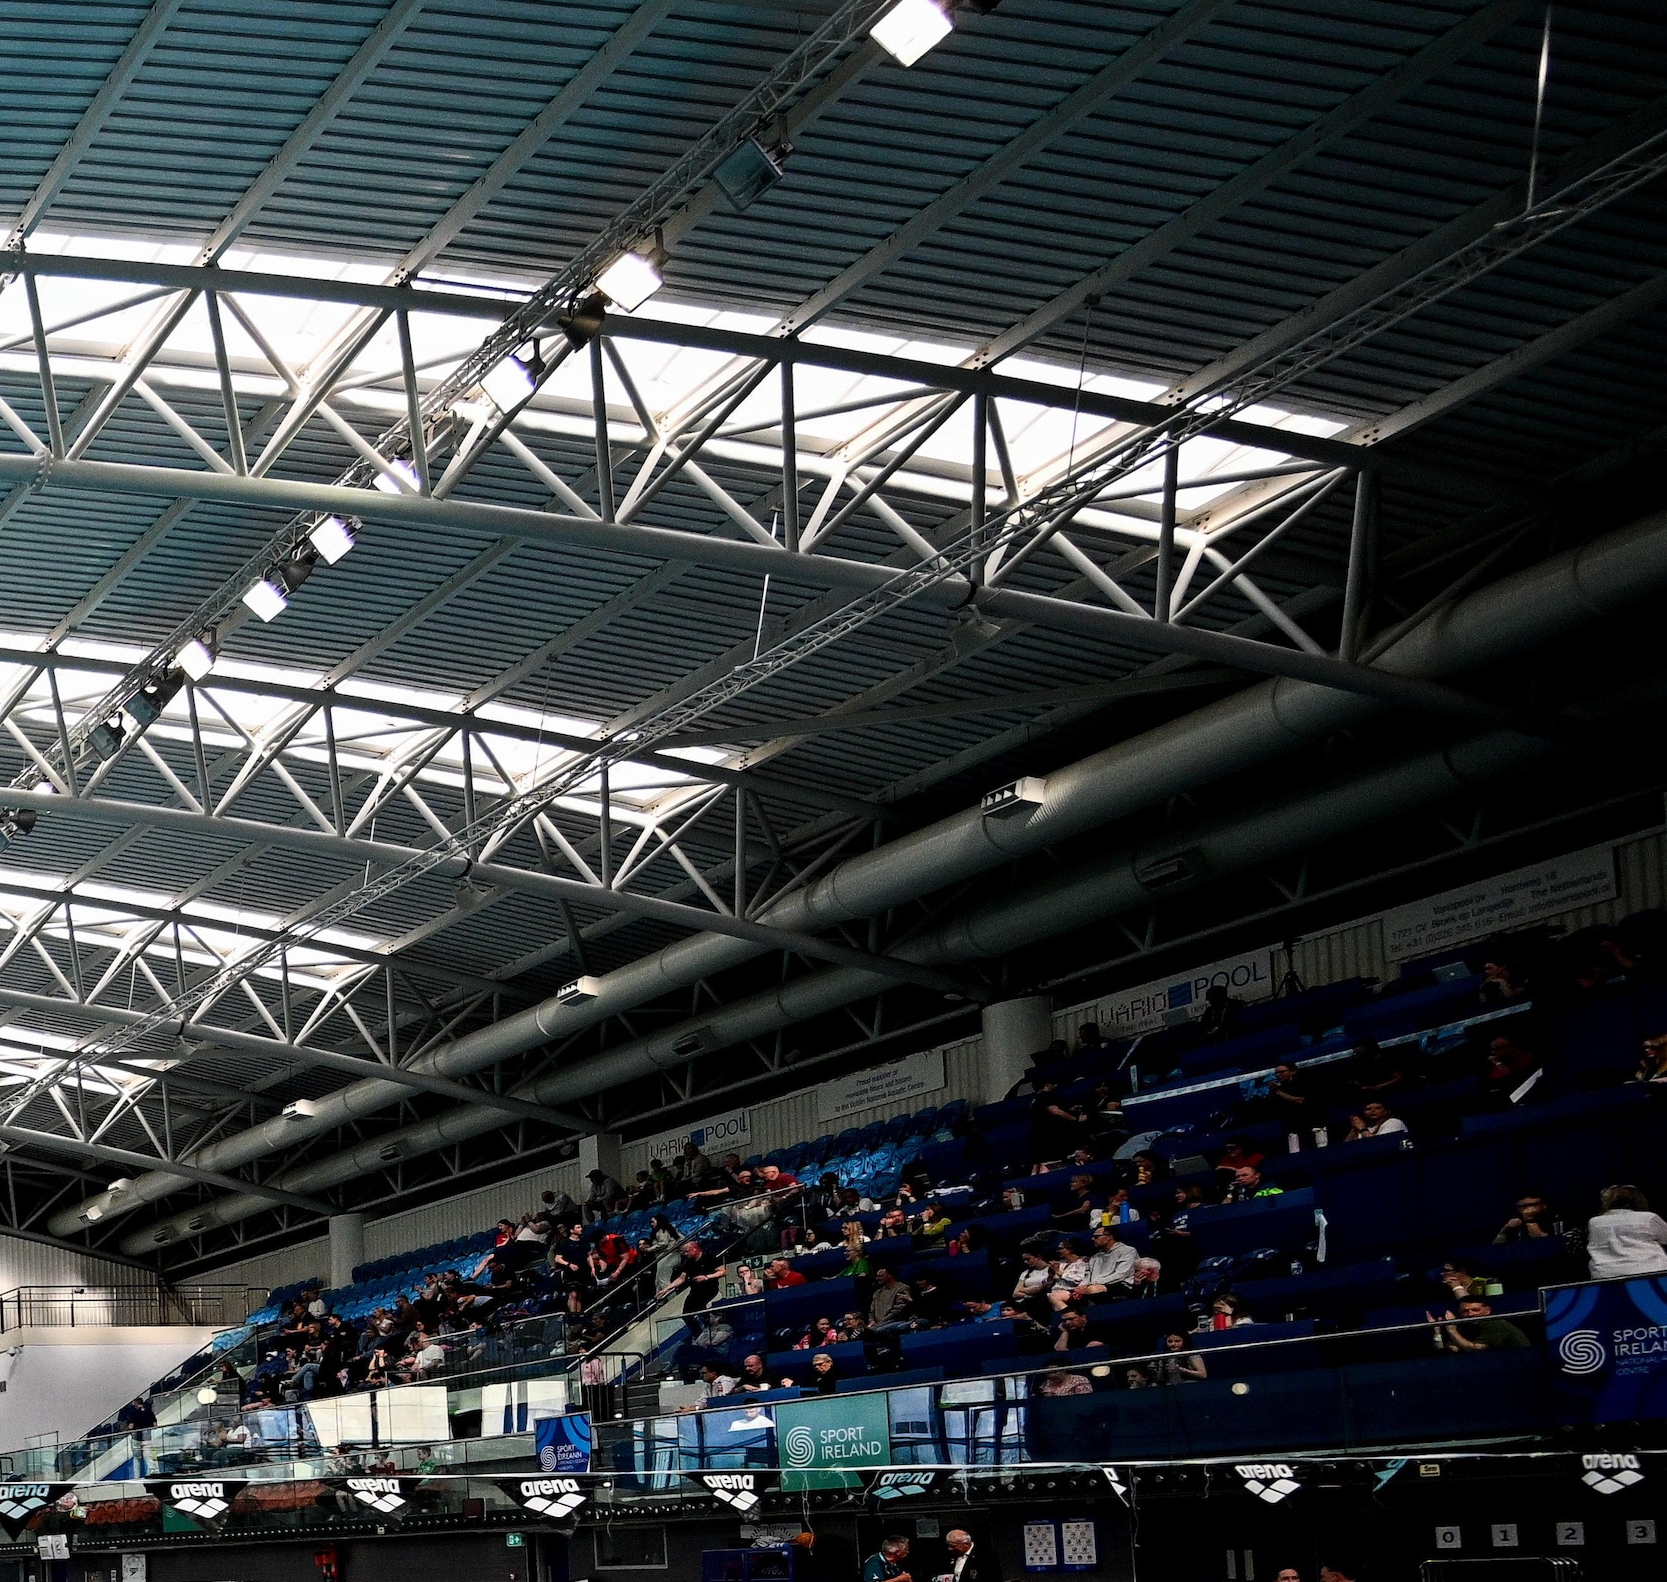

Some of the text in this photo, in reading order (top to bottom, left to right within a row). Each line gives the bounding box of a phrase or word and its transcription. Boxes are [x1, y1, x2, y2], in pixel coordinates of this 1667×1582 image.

[1194, 961, 1267, 999] POOL
[1613, 1325, 1667, 1342] SPORT
[820, 1426, 865, 1444] SPORT
[821, 1441, 882, 1460] IRELAND
[1581, 1453, 1641, 1471] arena
[880, 1471, 936, 1486] arena
[1234, 1464, 1293, 1479] arena
[170, 1482, 224, 1499] arena
[346, 1478, 400, 1495] arena
[520, 1478, 580, 1497] arena
[702, 1474, 755, 1490] arena
[1443, 1531, 1454, 1543] 0
[1500, 1529, 1510, 1542] 1
[1565, 1527, 1577, 1540] 2
[1634, 1525, 1648, 1540] 3
